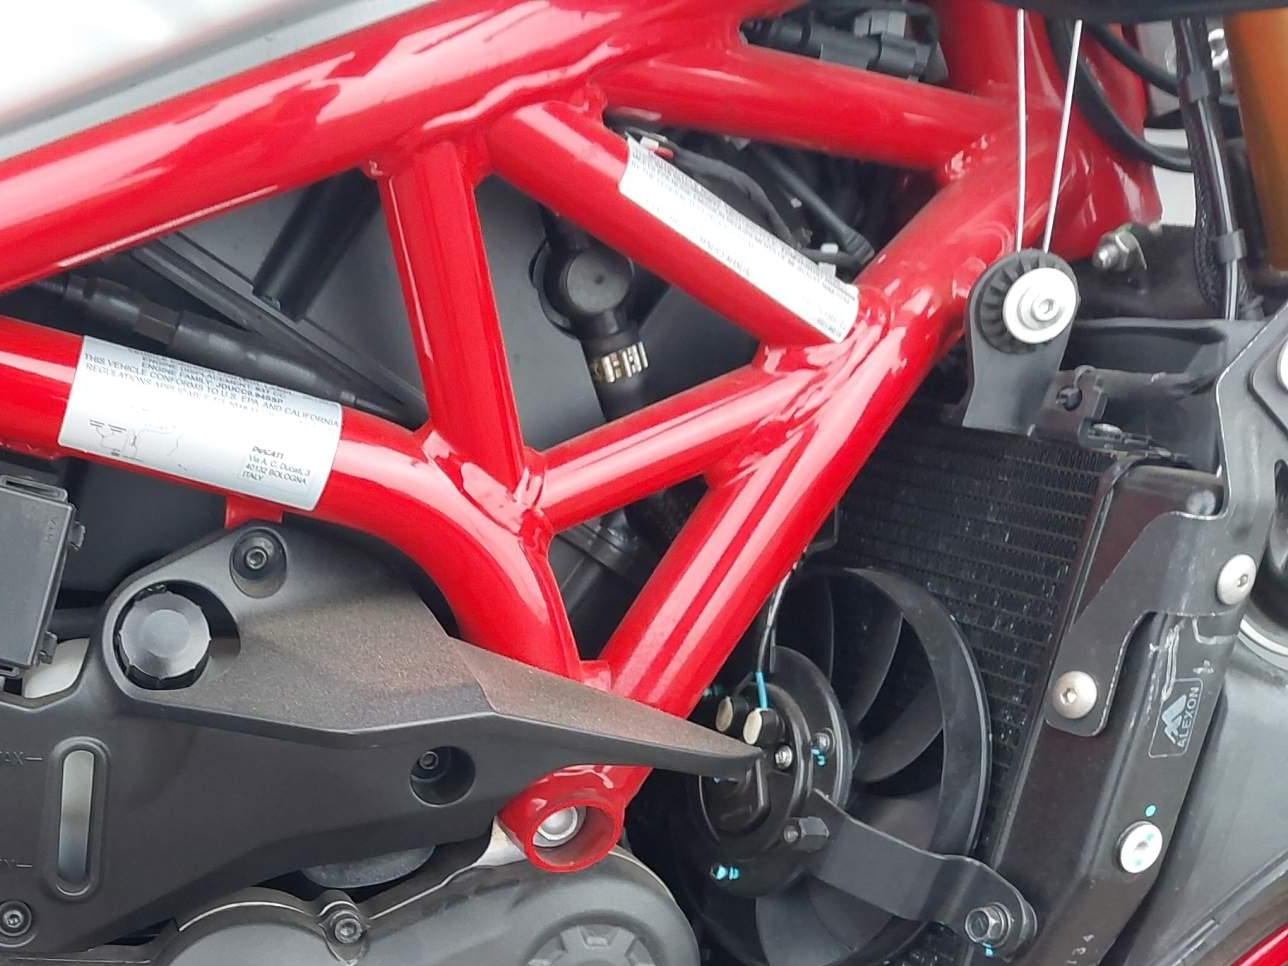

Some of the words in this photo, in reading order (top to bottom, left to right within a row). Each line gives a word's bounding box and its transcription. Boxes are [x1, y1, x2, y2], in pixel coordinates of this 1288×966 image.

[84, 351, 106, 365] THIS
[107, 359, 146, 376] VEHICLE
[149, 371, 205, 392] CONFORMS
[241, 394, 261, 406] EPA
[264, 400, 283, 412] AND
[284, 407, 340, 428] CALIFORNIA
[1177, 686, 1200, 748] ALEXON
